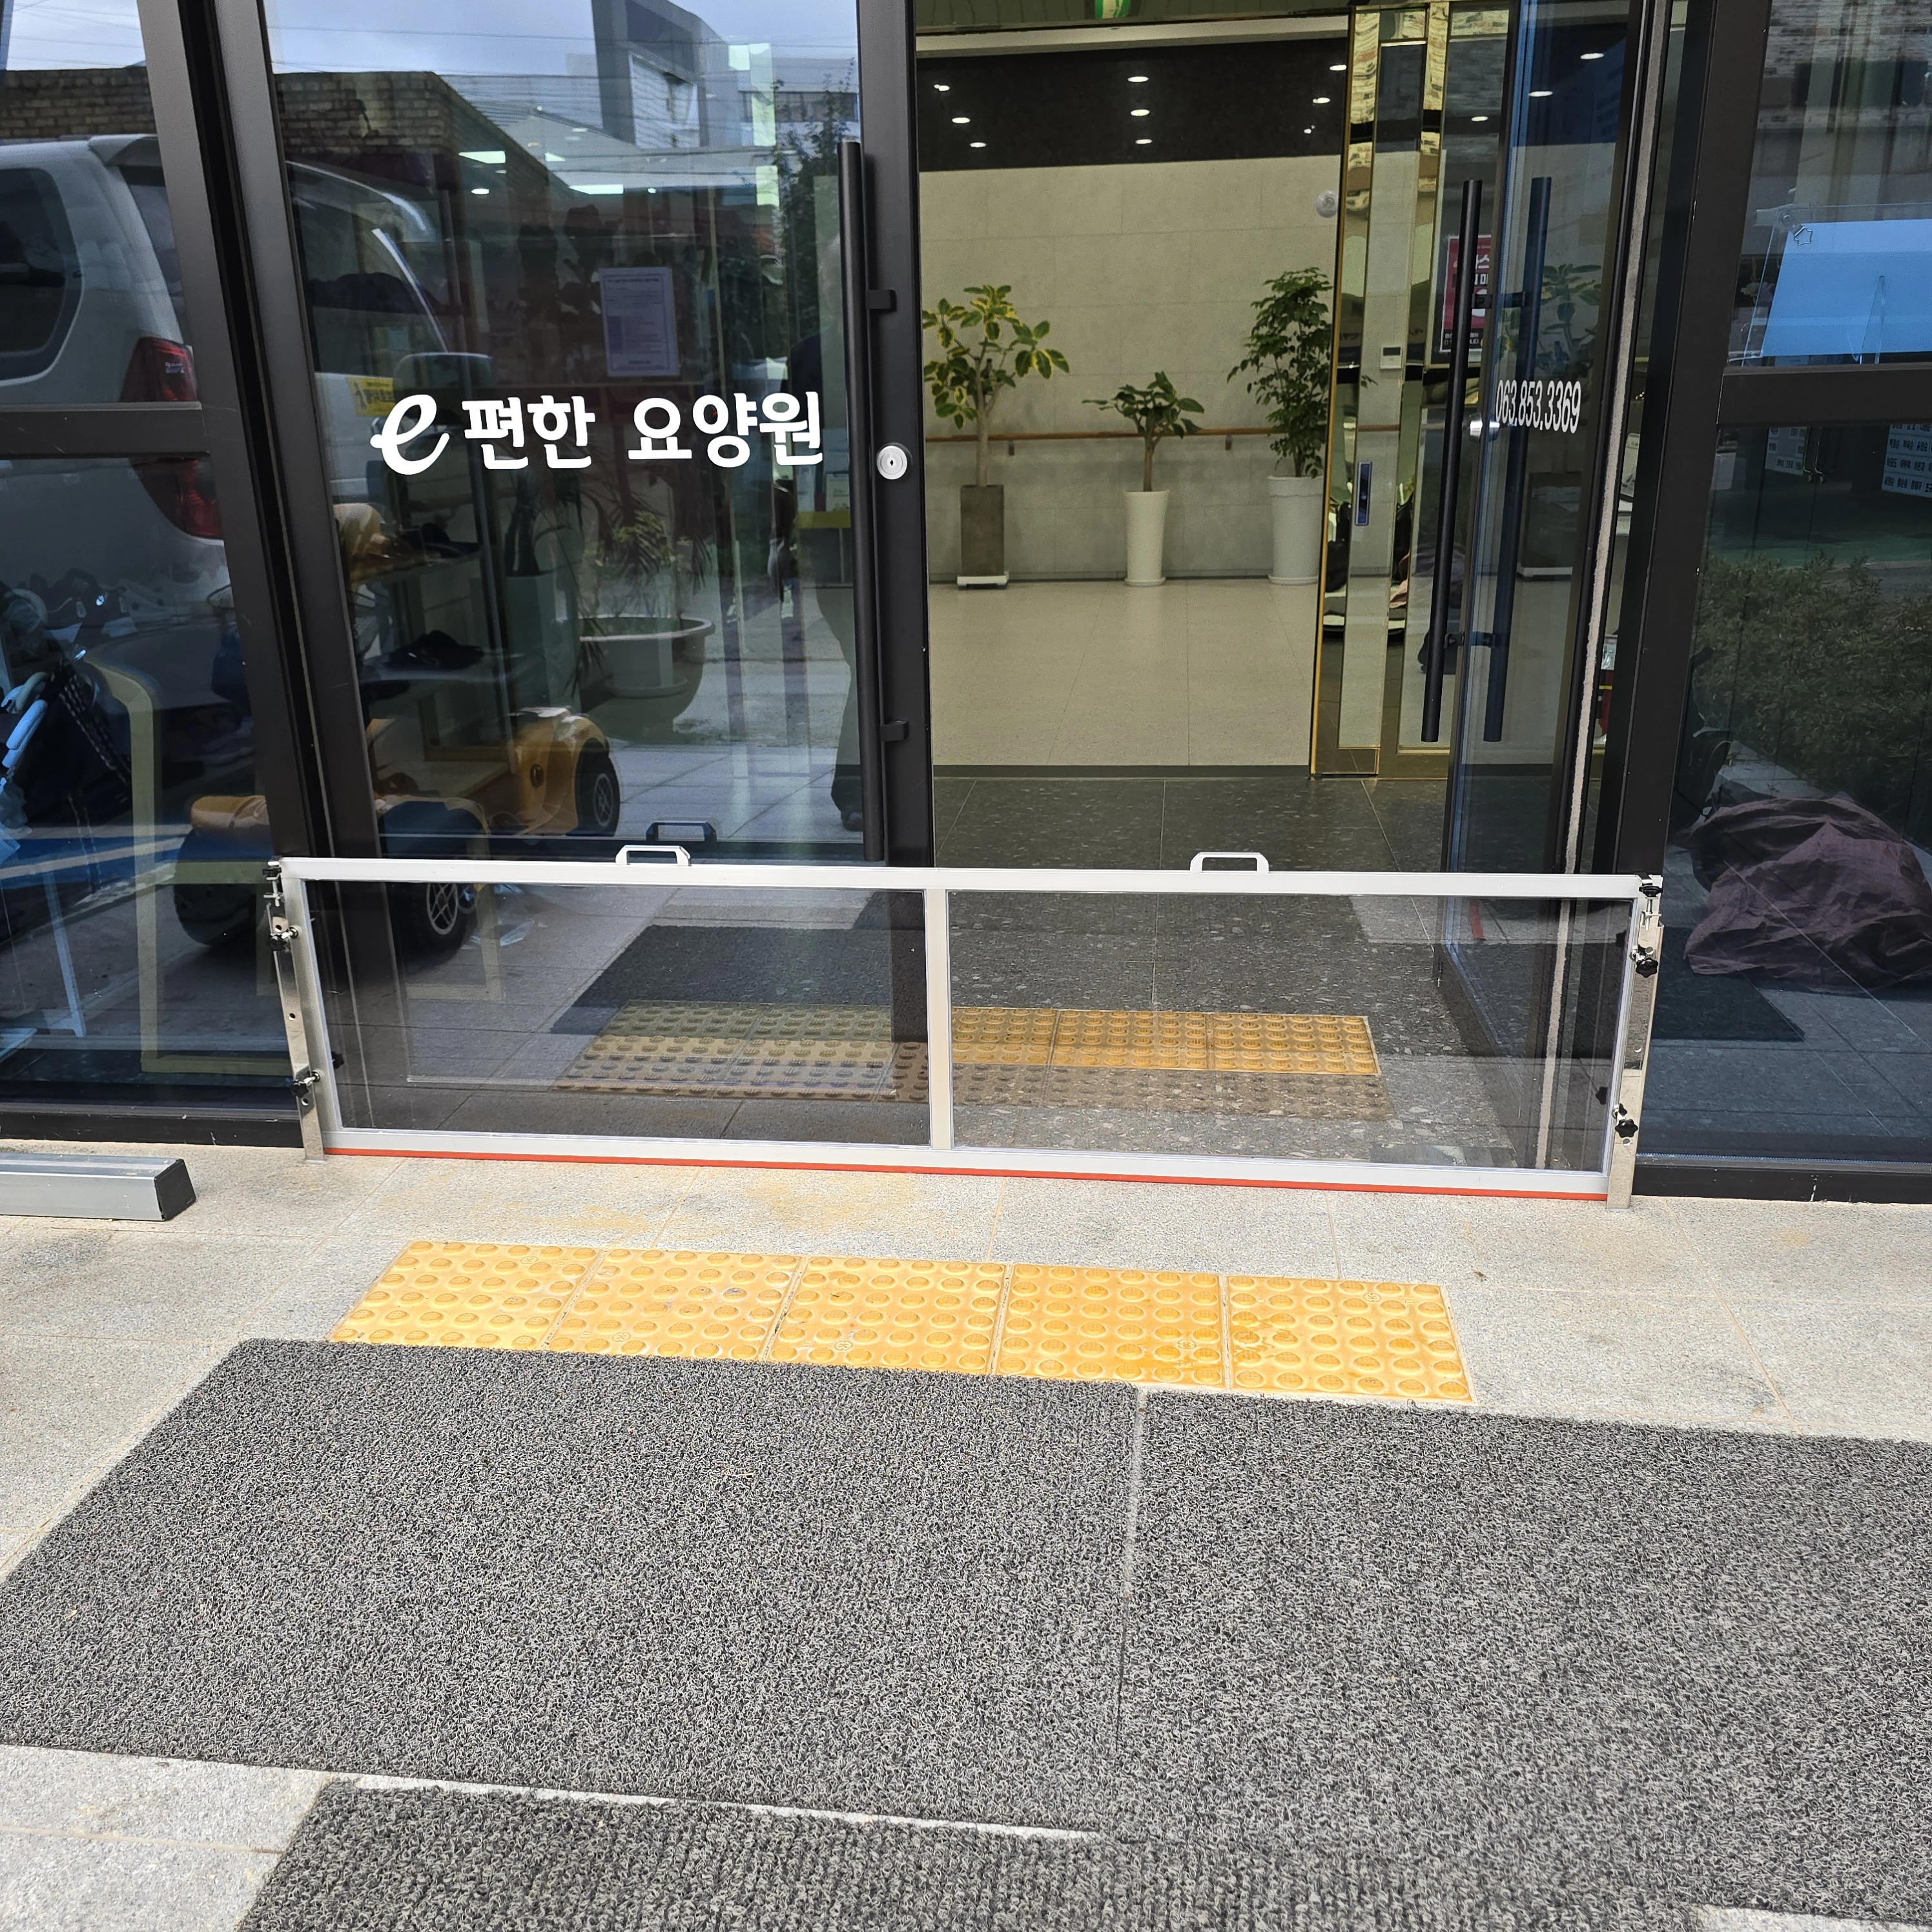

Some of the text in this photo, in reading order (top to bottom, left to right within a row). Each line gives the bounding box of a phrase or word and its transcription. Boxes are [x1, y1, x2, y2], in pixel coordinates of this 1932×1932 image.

[370, 391, 823, 475] e 편한 요양원
[1495, 379, 1581, 434] 063.853.3369
